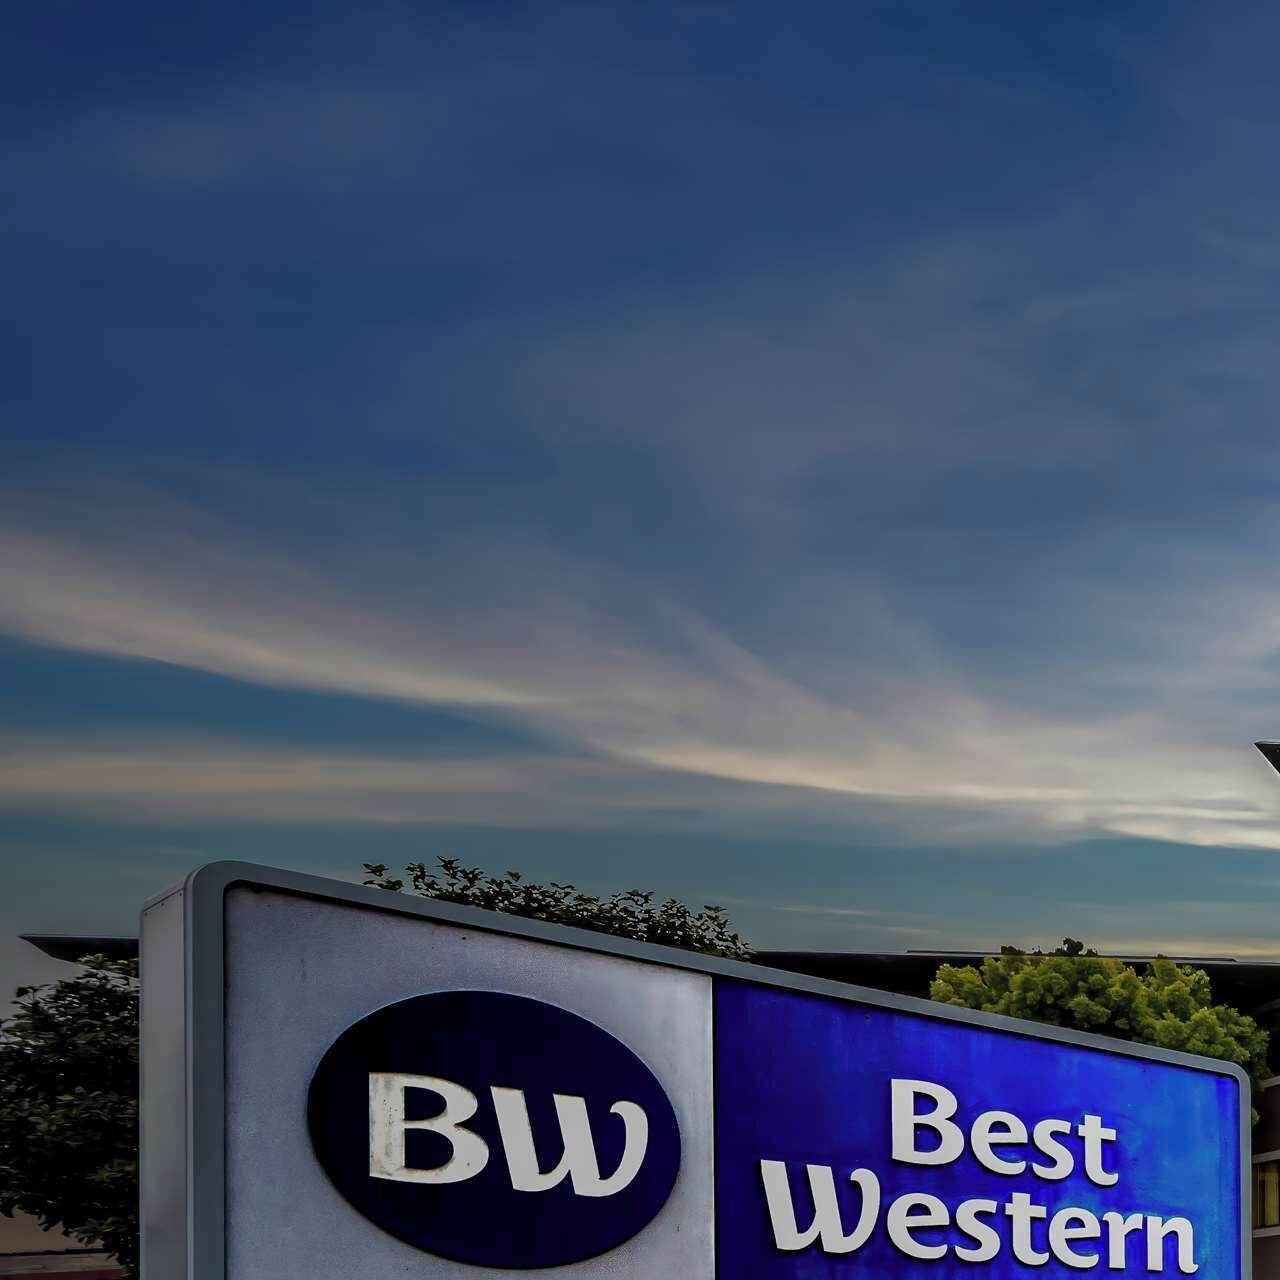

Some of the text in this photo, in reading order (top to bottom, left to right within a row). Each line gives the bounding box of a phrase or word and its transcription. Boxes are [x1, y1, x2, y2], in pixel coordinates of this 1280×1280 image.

[368, 1071, 649, 1198] BW
[890, 1078, 1119, 1186] Best
[760, 1159, 1199, 1274] Western
